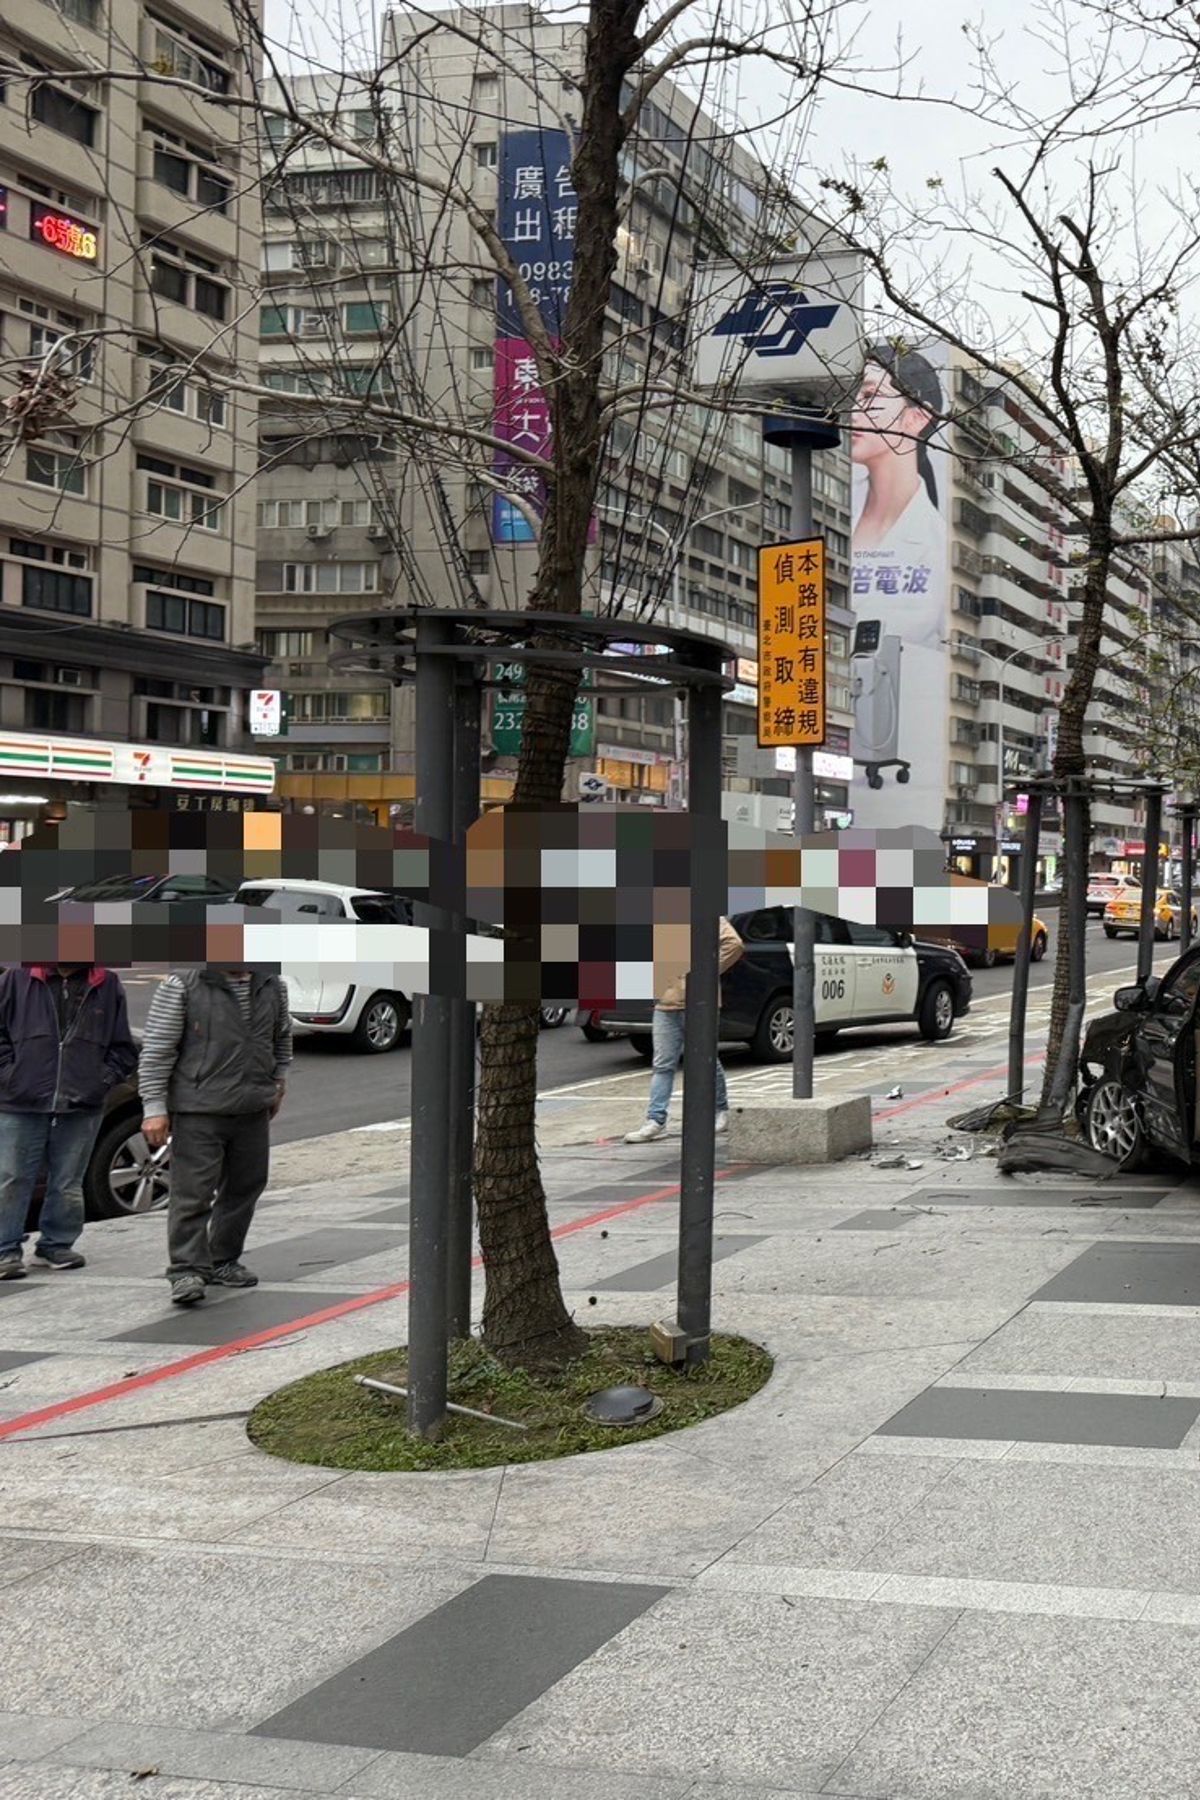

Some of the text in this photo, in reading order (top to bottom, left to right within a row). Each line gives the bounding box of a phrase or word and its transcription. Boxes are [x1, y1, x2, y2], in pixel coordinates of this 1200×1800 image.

[774, 552, 795, 737] 偵測取締
[797, 549, 819, 735] 本路段有違規
[821, 980, 845, 1000] 006
